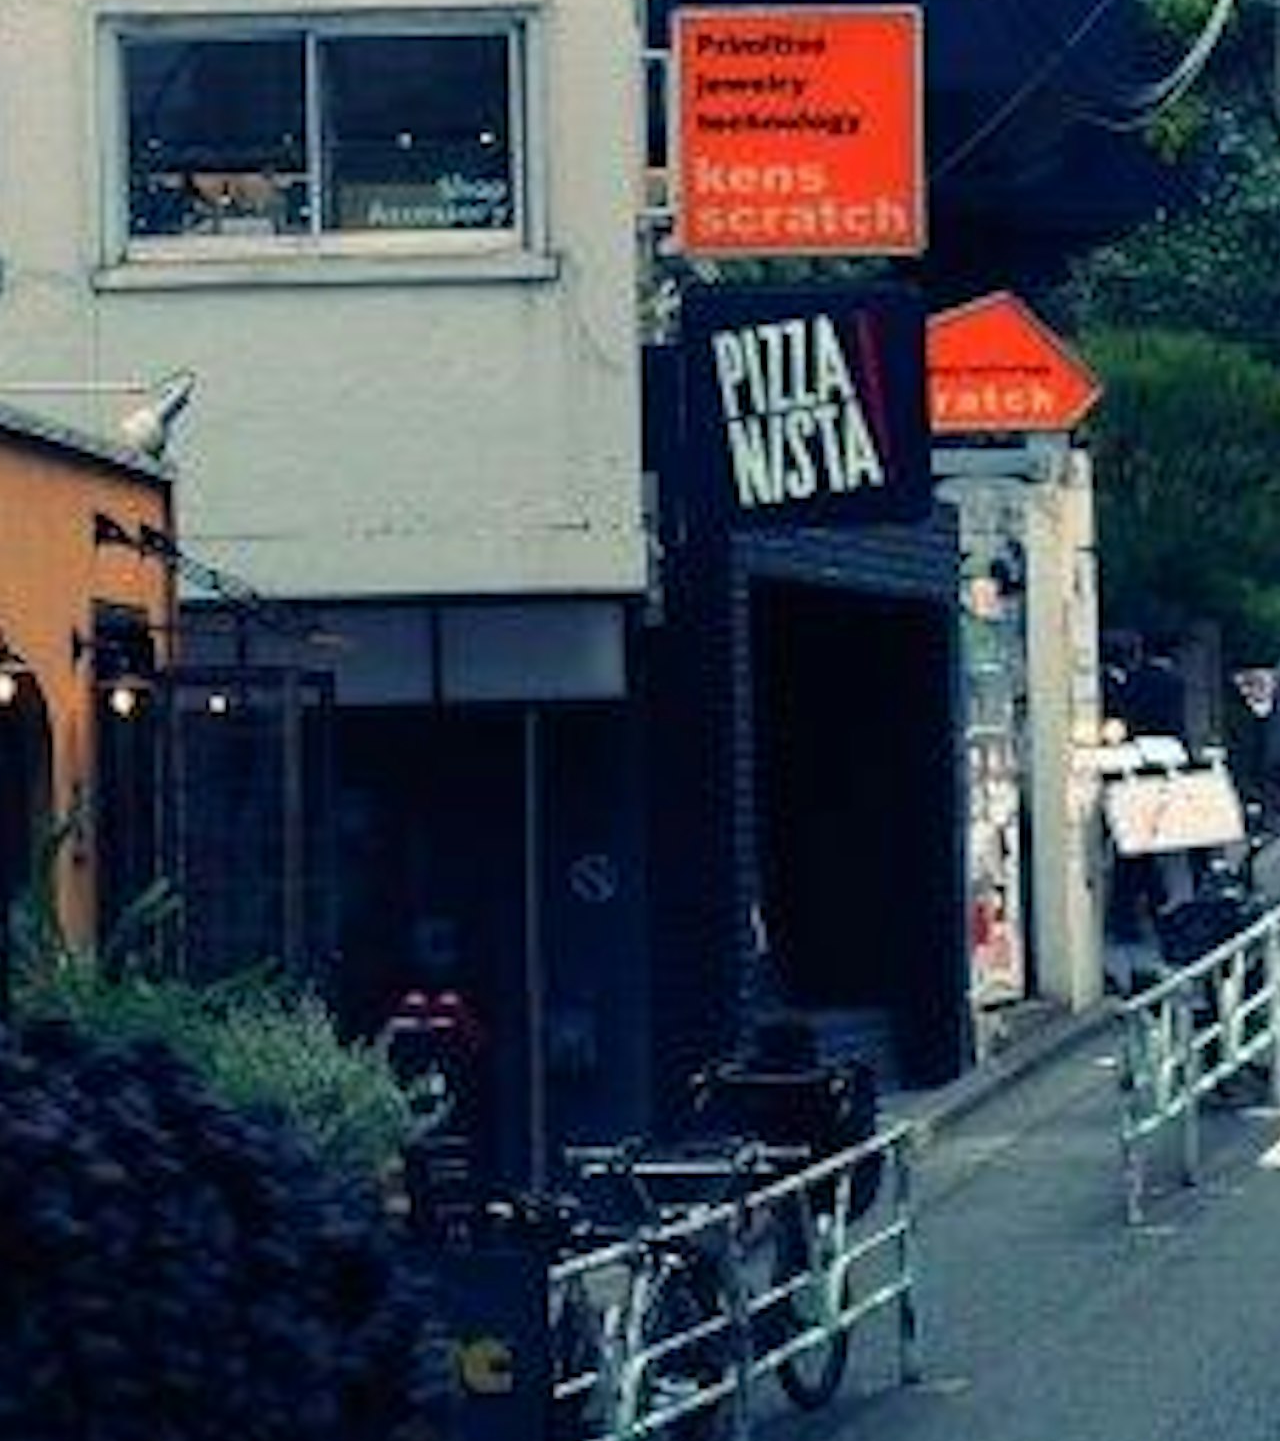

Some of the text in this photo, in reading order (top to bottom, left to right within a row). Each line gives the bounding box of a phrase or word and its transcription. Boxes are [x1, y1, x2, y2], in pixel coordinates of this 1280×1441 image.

[694, 156, 827, 195] kens
[695, 196, 909, 237] scratch
[713, 313, 857, 416] PIZZA
[727, 401, 886, 509] NISTA
